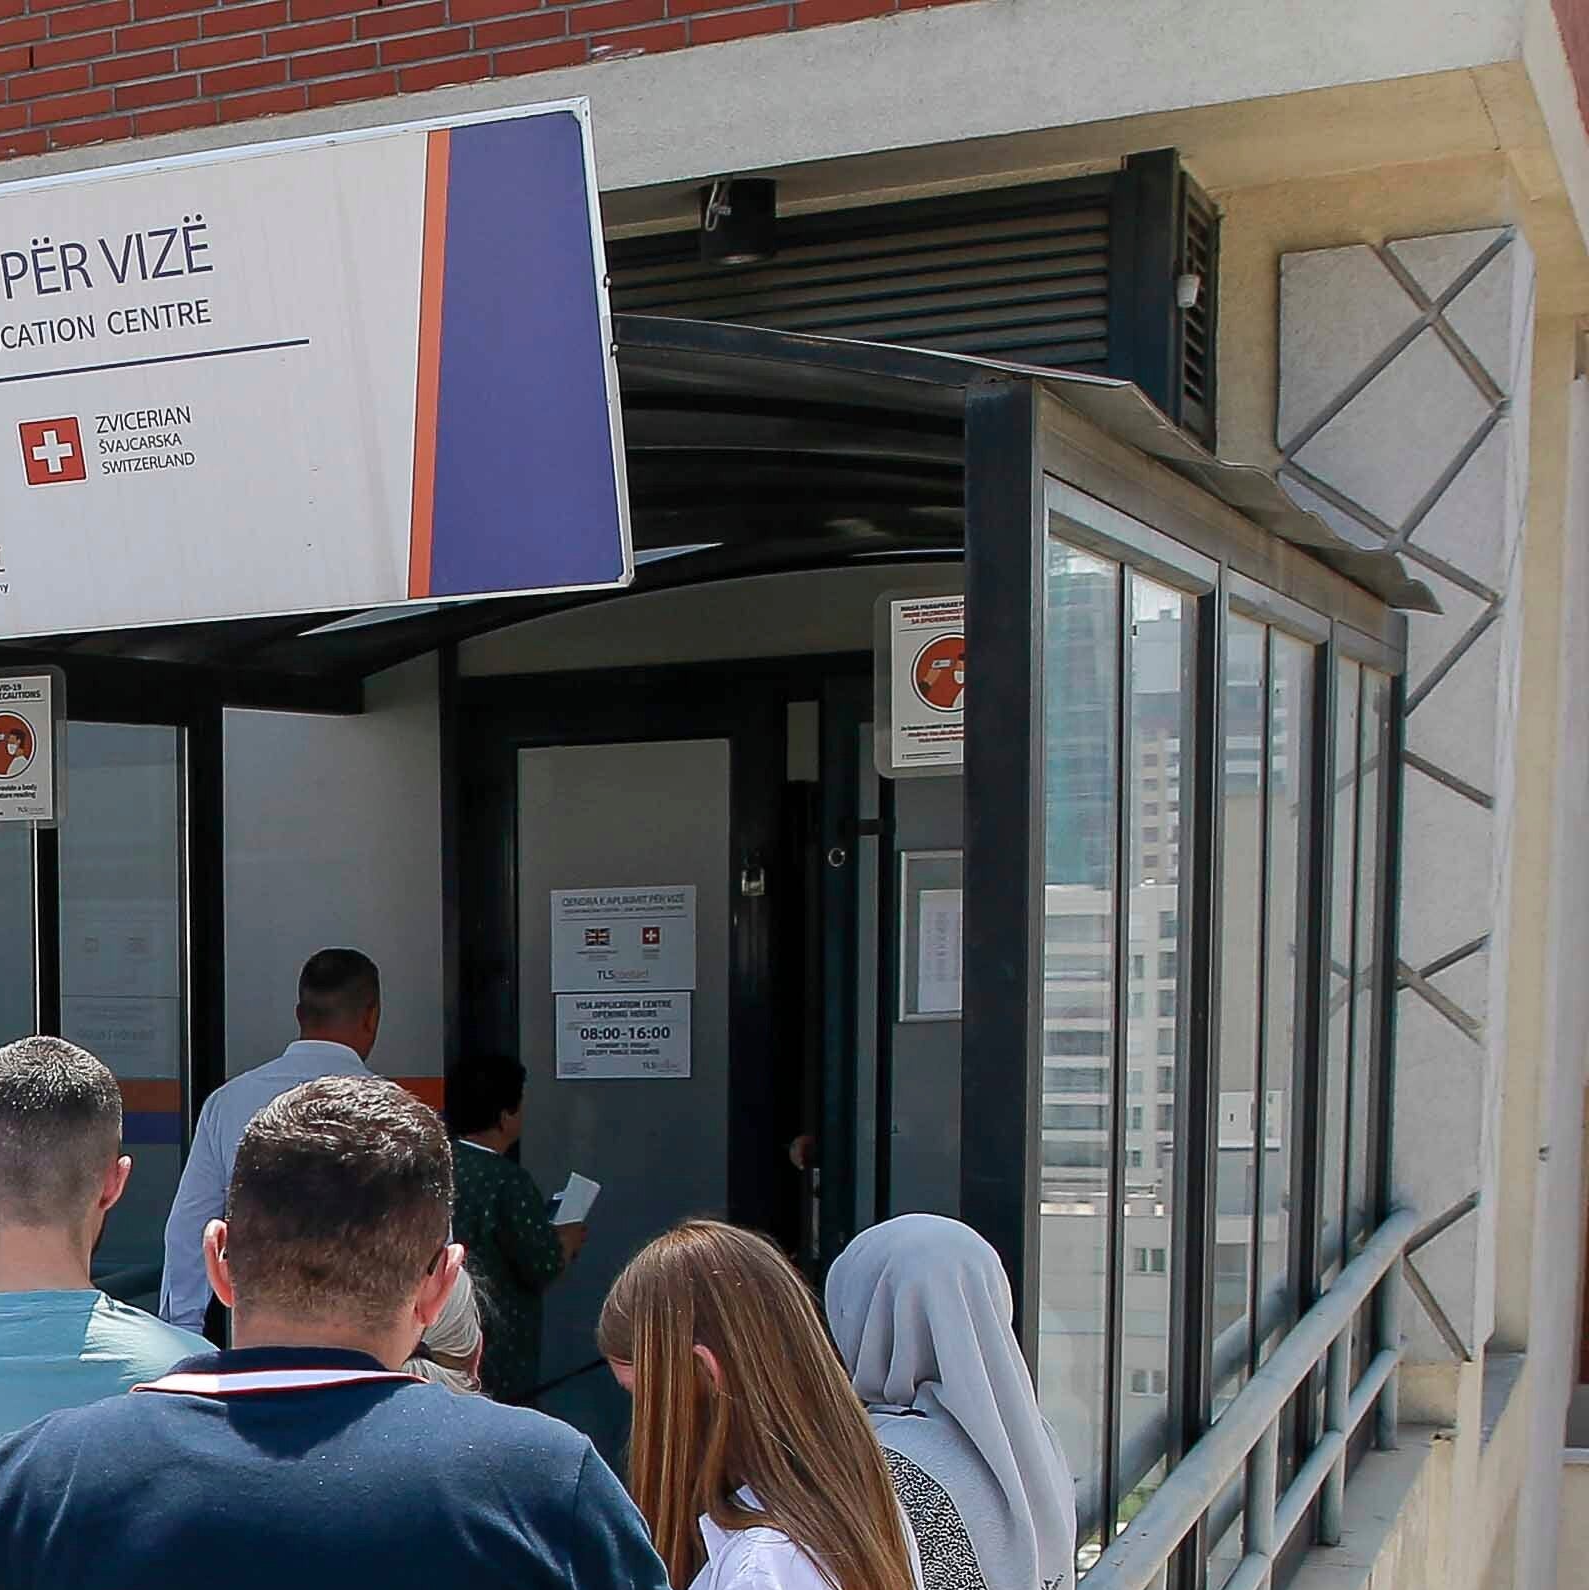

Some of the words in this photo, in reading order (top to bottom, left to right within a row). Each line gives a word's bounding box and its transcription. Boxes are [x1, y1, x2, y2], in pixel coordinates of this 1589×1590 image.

[0, 237, 93, 299] PËR
[99, 214, 213, 284] VIZË
[108, 299, 212, 335] CENTRE
[95, 406, 191, 433] ZVICERIAN
[99, 433, 182, 454] ŠVAJCARSKA
[102, 452, 195, 474] SWITZERLAND
[581, 1026, 670, 1040] 08:00-16:00
